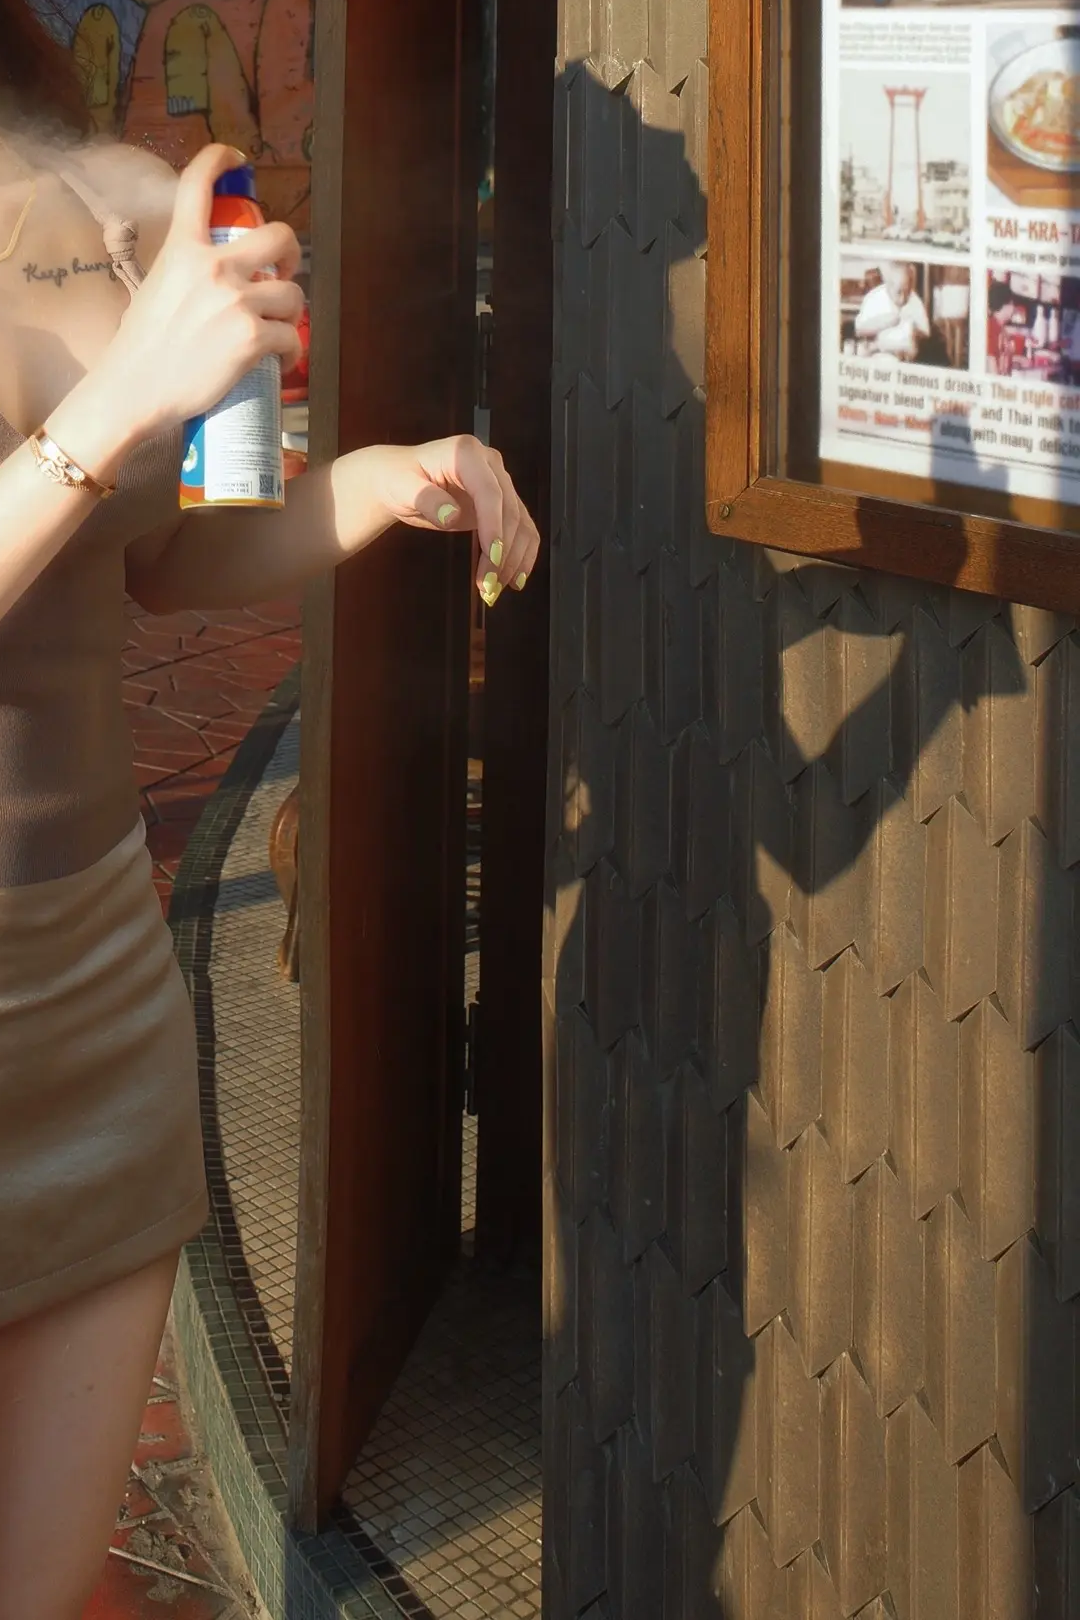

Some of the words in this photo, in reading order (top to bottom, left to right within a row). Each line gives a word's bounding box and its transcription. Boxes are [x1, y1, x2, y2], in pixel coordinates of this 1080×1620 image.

[22, 262, 68, 288] Keep
[838, 359, 869, 383] Enjoy
[874, 369, 891, 382] our
[897, 368, 939, 390] famous
[944, 377, 981, 396] drinks
[991, 382, 1018, 401] Thai
[1022, 389, 1053, 409] style
[838, 384, 889, 404] signature
[894, 390, 925, 409] blend
[981, 407, 1002, 422] and
[1008, 408, 1032, 425] Thai
[1037, 414, 1063, 432] milk
[973, 428, 997, 444] with
[1000, 432, 1033, 453] many
